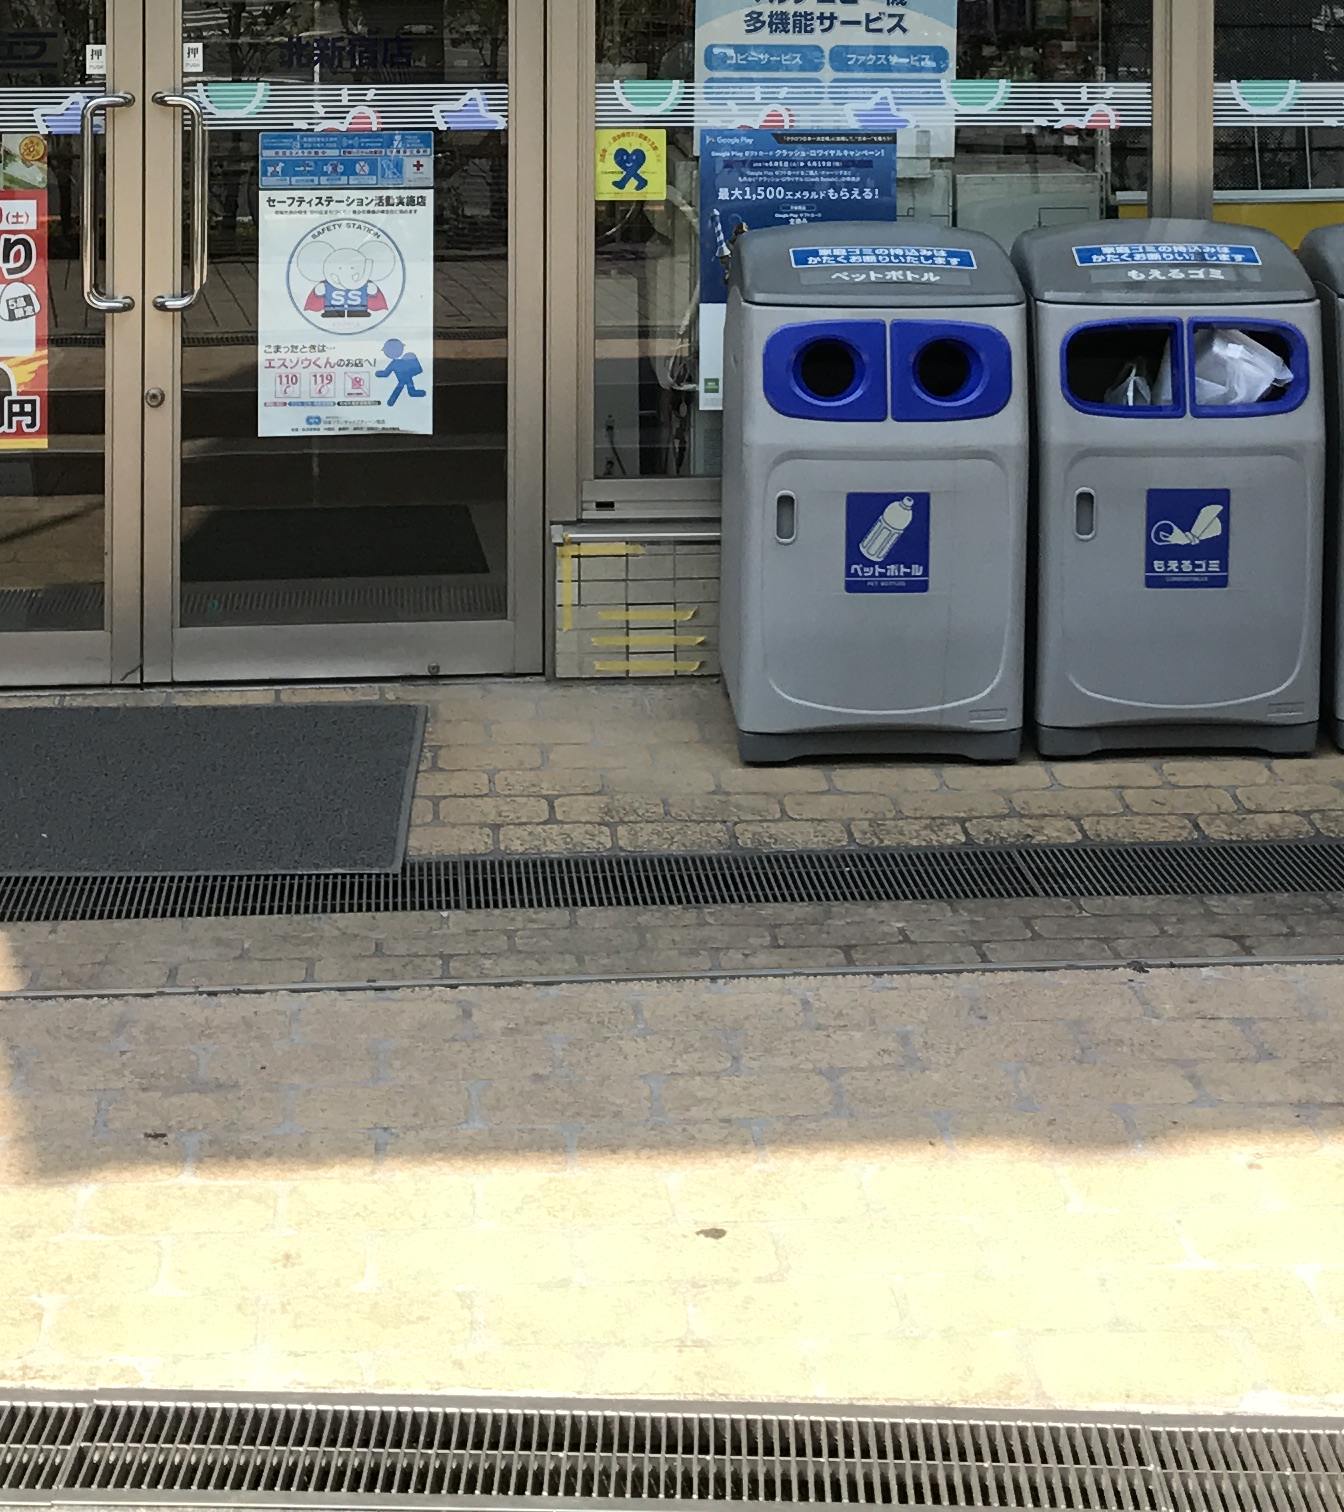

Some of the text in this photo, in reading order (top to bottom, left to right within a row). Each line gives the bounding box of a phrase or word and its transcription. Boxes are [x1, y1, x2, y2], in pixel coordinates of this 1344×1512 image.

[744, 10, 908, 34] 多機能サービス
[89, 46, 103, 61] 押
[186, 46, 200, 61] 押
[279, 35, 413, 69] 北新宿店
[726, 51, 931, 66] コピーサービス ファクスサービス
[717, 136, 754, 145] Google Play
[718, 186, 879, 201] 最大1,500エメラルドもらえる!
[266, 195, 427, 208] セーフティステーション活動実施店
[311, 222, 381, 240] SAFETY STATION
[819, 248, 947, 257] 家庭ゴミの持込みは
[1100, 245, 1230, 255] 家庭ゴミの持込みは
[807, 256, 961, 266] かたくお断りいたします
[830, 270, 941, 282] ペットボトル
[1127, 268, 1225, 281] もえるゴミ
[330, 290, 362, 305] SS
[277, 374, 333, 385] 110 119
[850, 563, 924, 577] ペットボトル
[1153, 560, 1221, 572] もえるゴミ
